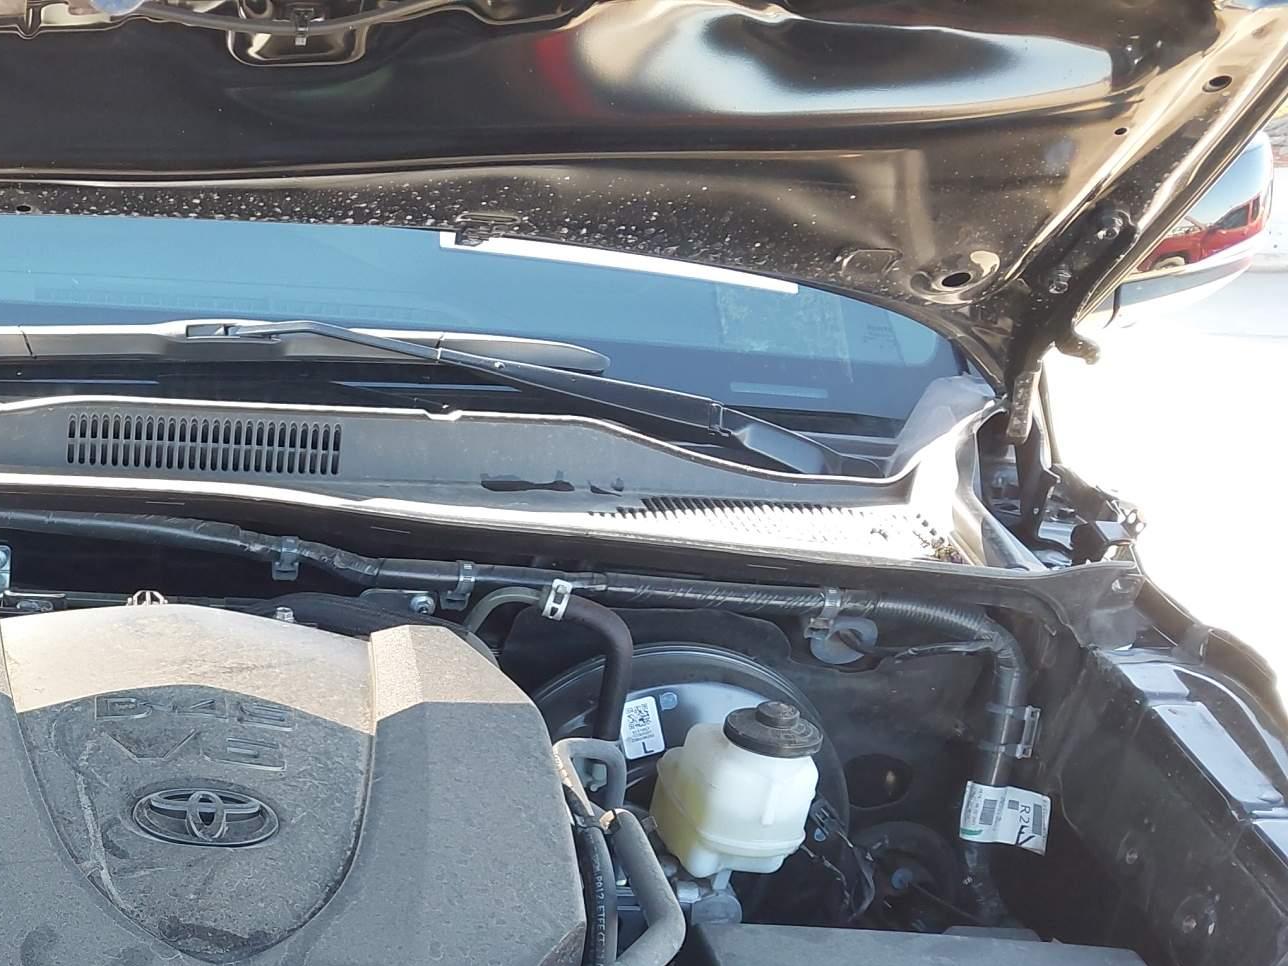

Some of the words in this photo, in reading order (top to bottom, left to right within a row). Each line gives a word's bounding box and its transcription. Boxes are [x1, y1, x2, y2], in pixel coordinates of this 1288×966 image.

[95, 695, 297, 731] D-4S
[103, 727, 287, 772] V6
[640, 741, 655, 754] L
